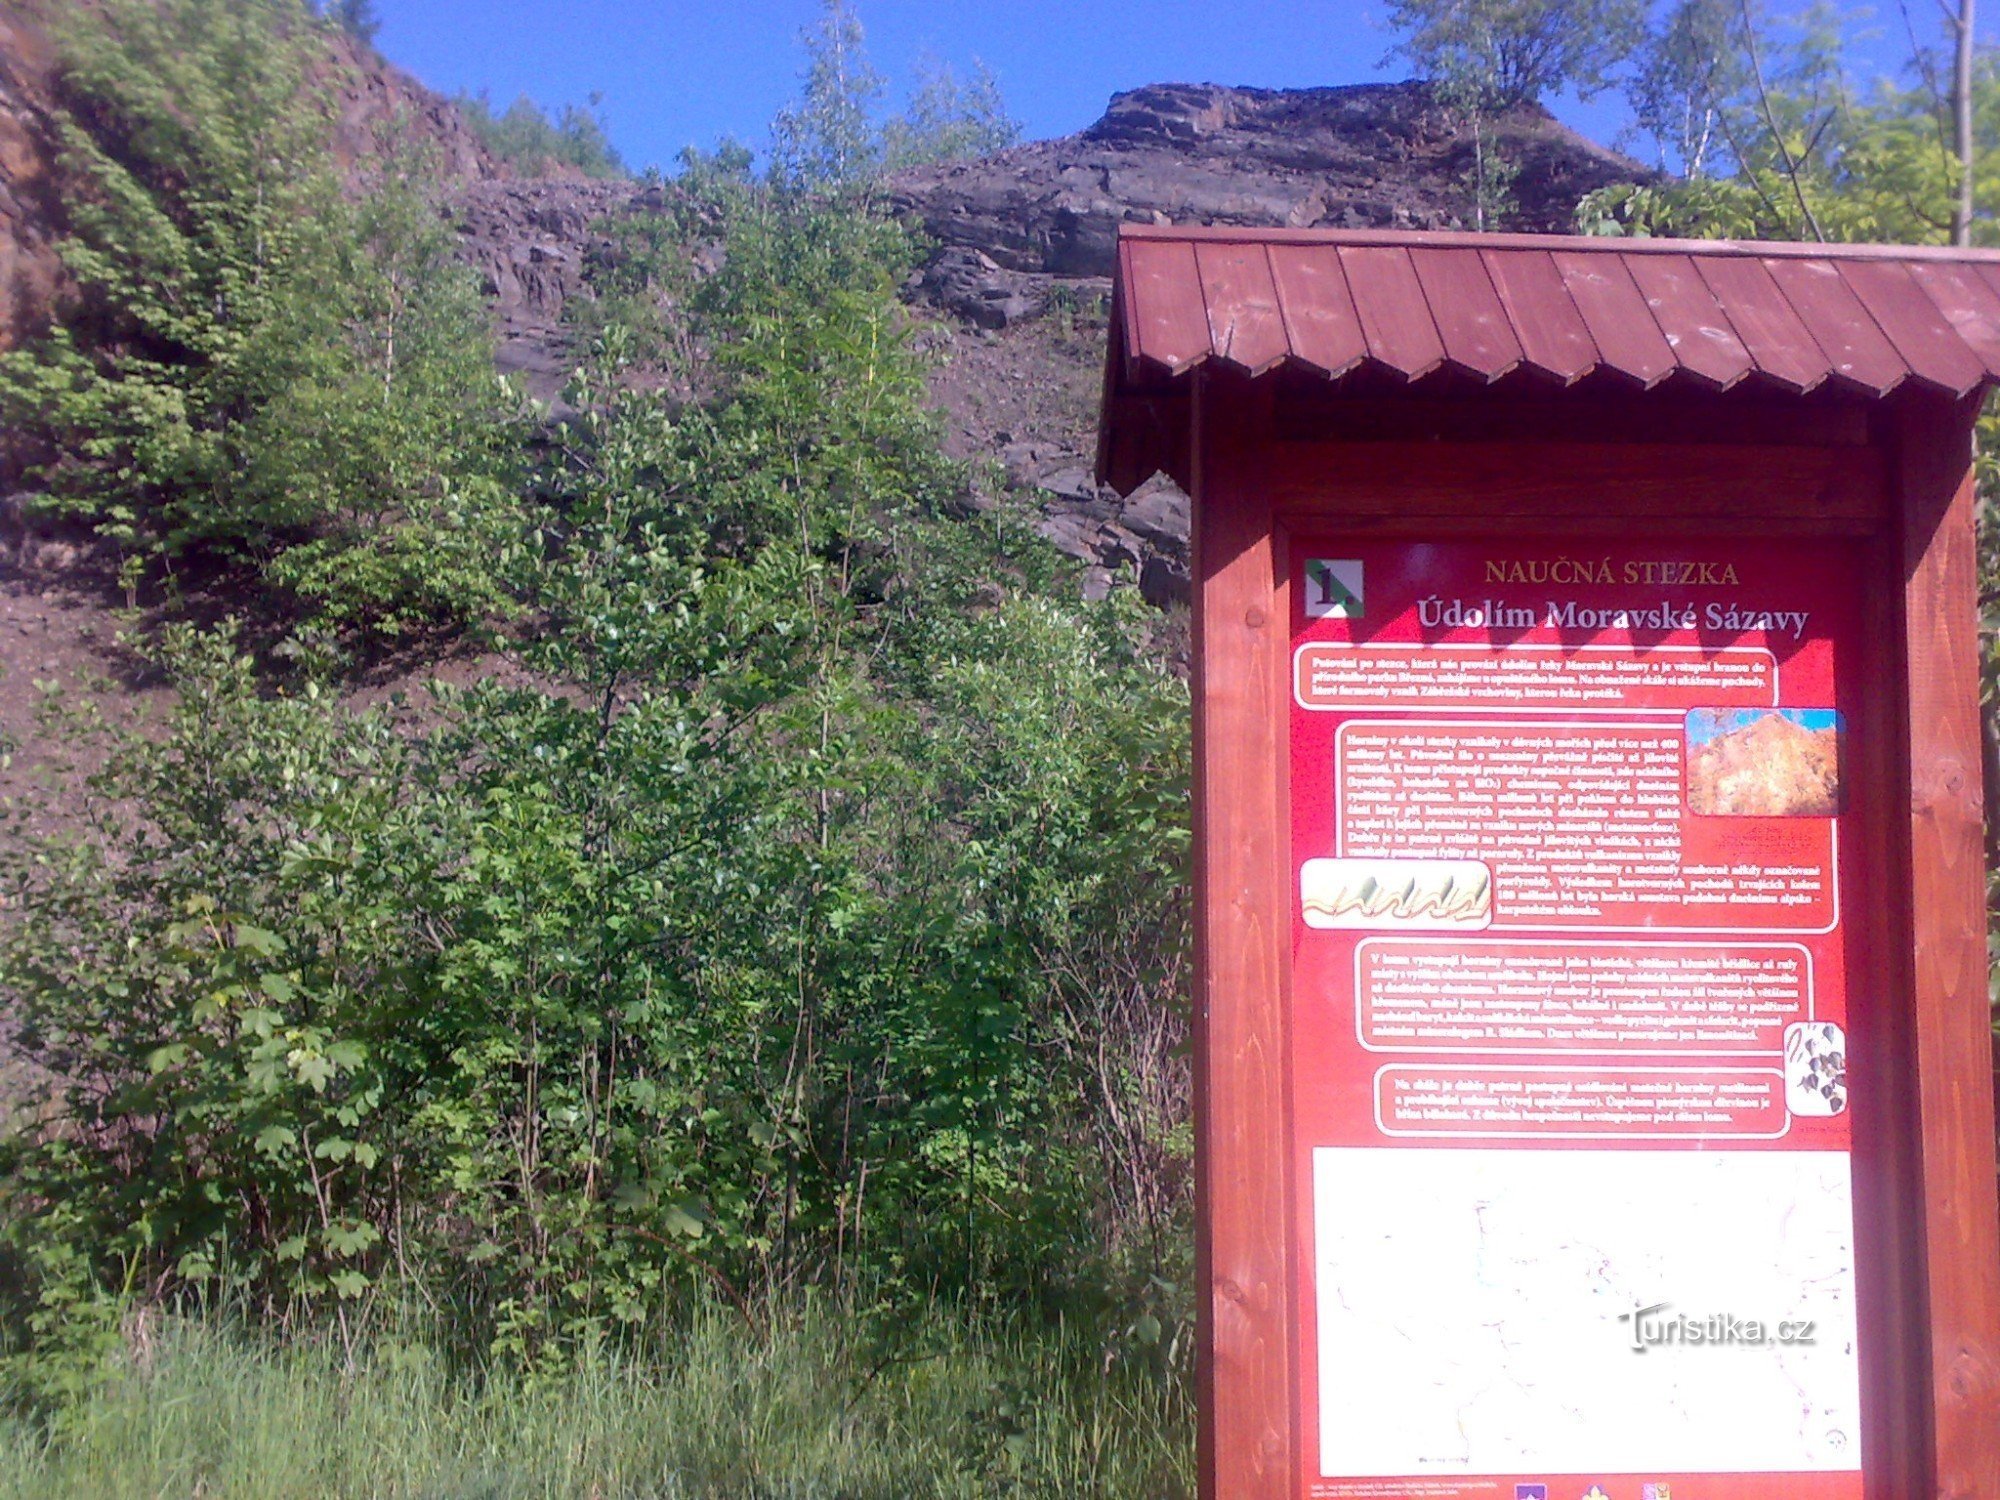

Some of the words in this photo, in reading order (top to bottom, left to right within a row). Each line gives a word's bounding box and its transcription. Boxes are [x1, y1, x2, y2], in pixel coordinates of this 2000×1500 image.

[1486, 556, 1614, 585] NAUČNÁ
[1624, 560, 1739, 585] STEZKA
[1417, 595, 1536, 628] Údolím
[1545, 599, 1696, 630] Moravské
[1705, 603, 1809, 640] Sázavy
